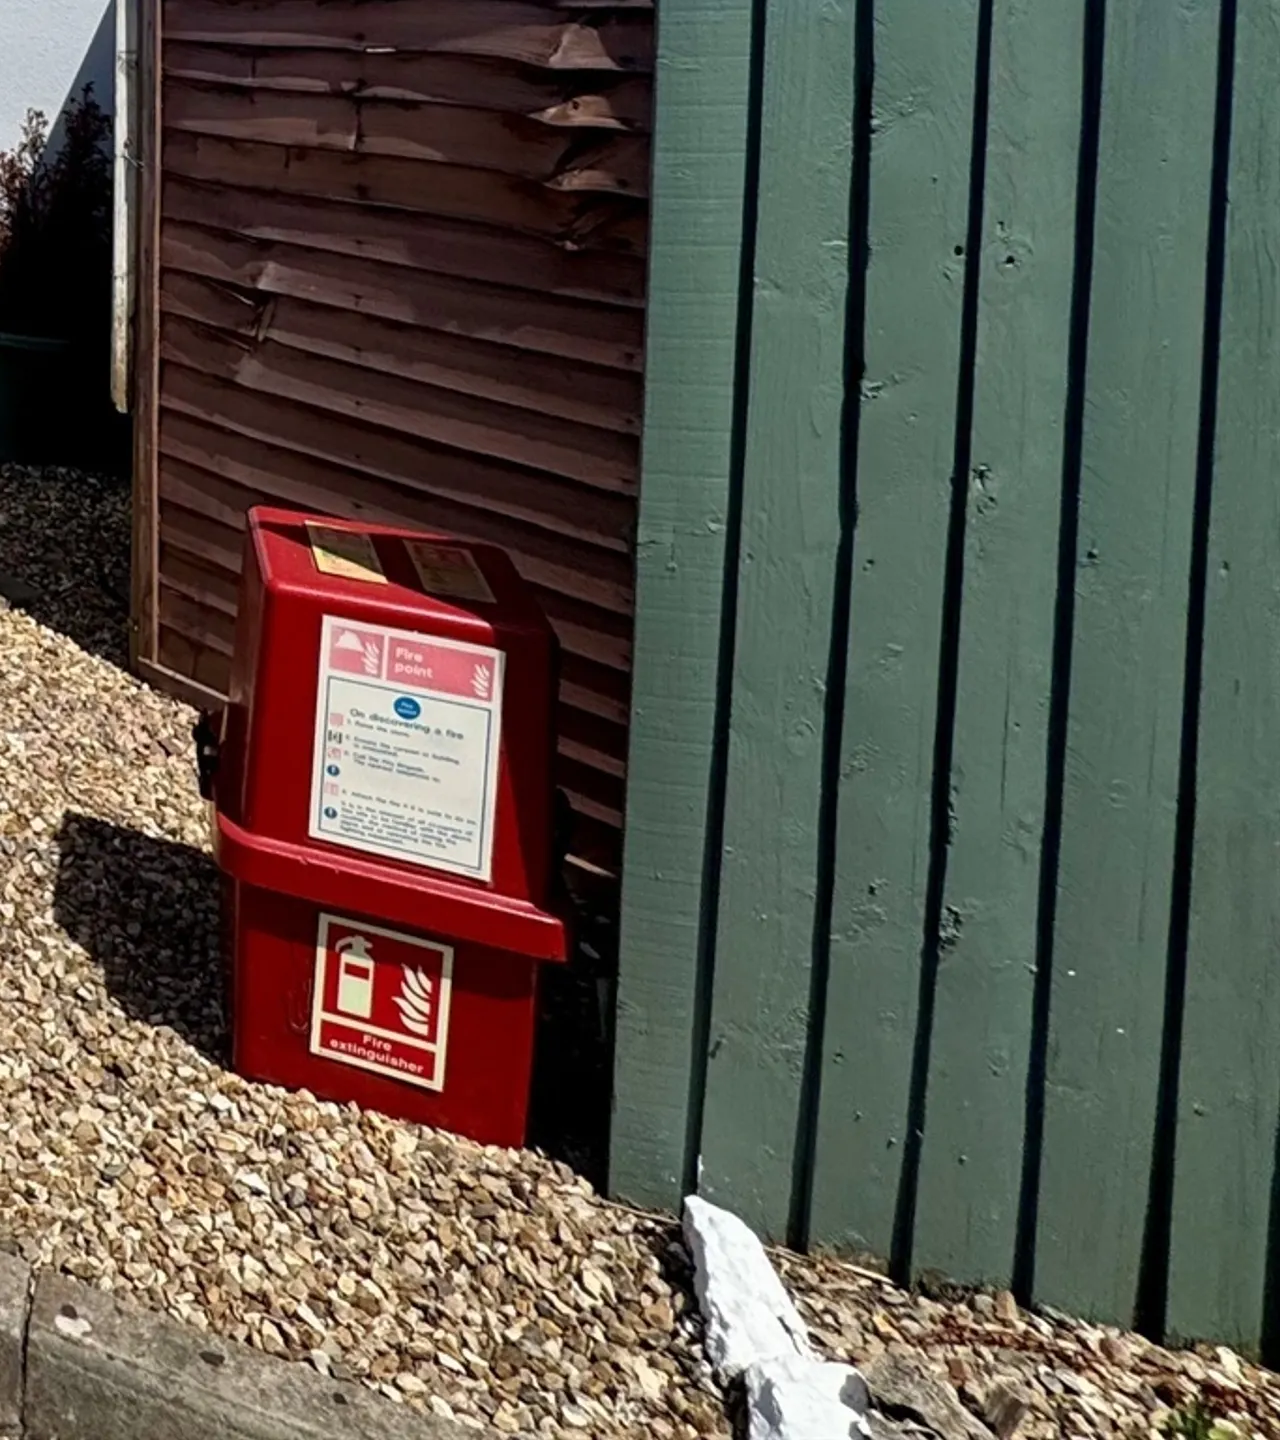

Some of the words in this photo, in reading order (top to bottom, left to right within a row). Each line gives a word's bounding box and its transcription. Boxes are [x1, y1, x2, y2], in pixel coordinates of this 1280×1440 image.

[395, 647, 423, 662] Fire
[394, 663, 434, 679] point
[349, 708, 366, 719] On
[369, 713, 431, 734] discovering
[446, 728, 464, 740] fire
[362, 1035, 392, 1051] Fire
[329, 1038, 425, 1074] extinguisher
